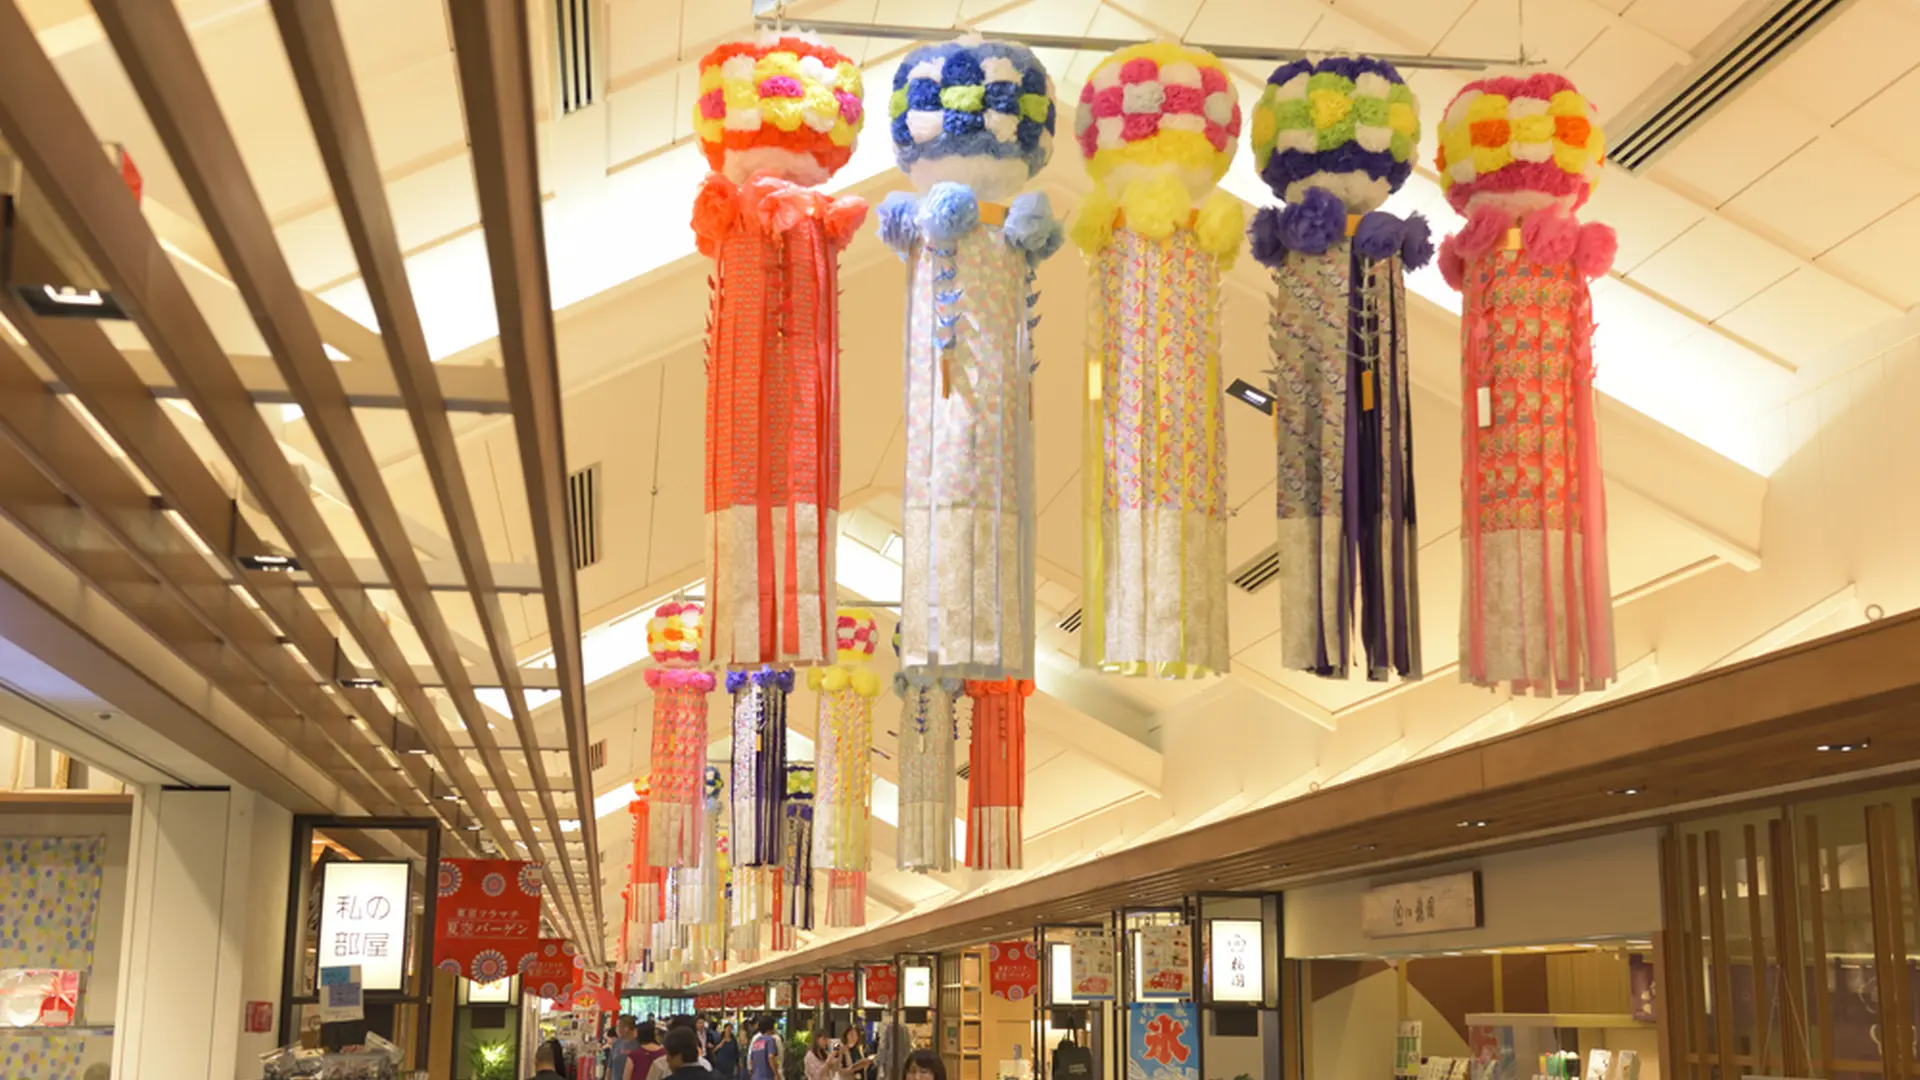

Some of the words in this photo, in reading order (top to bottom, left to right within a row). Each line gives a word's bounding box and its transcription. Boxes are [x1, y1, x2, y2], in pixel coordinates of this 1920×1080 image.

[336, 895, 391, 920] 私の
[447, 920, 529, 936] 夏空バーゲン
[334, 932, 389, 957] 部屋
[1143, 1013, 1191, 1065] 氷
